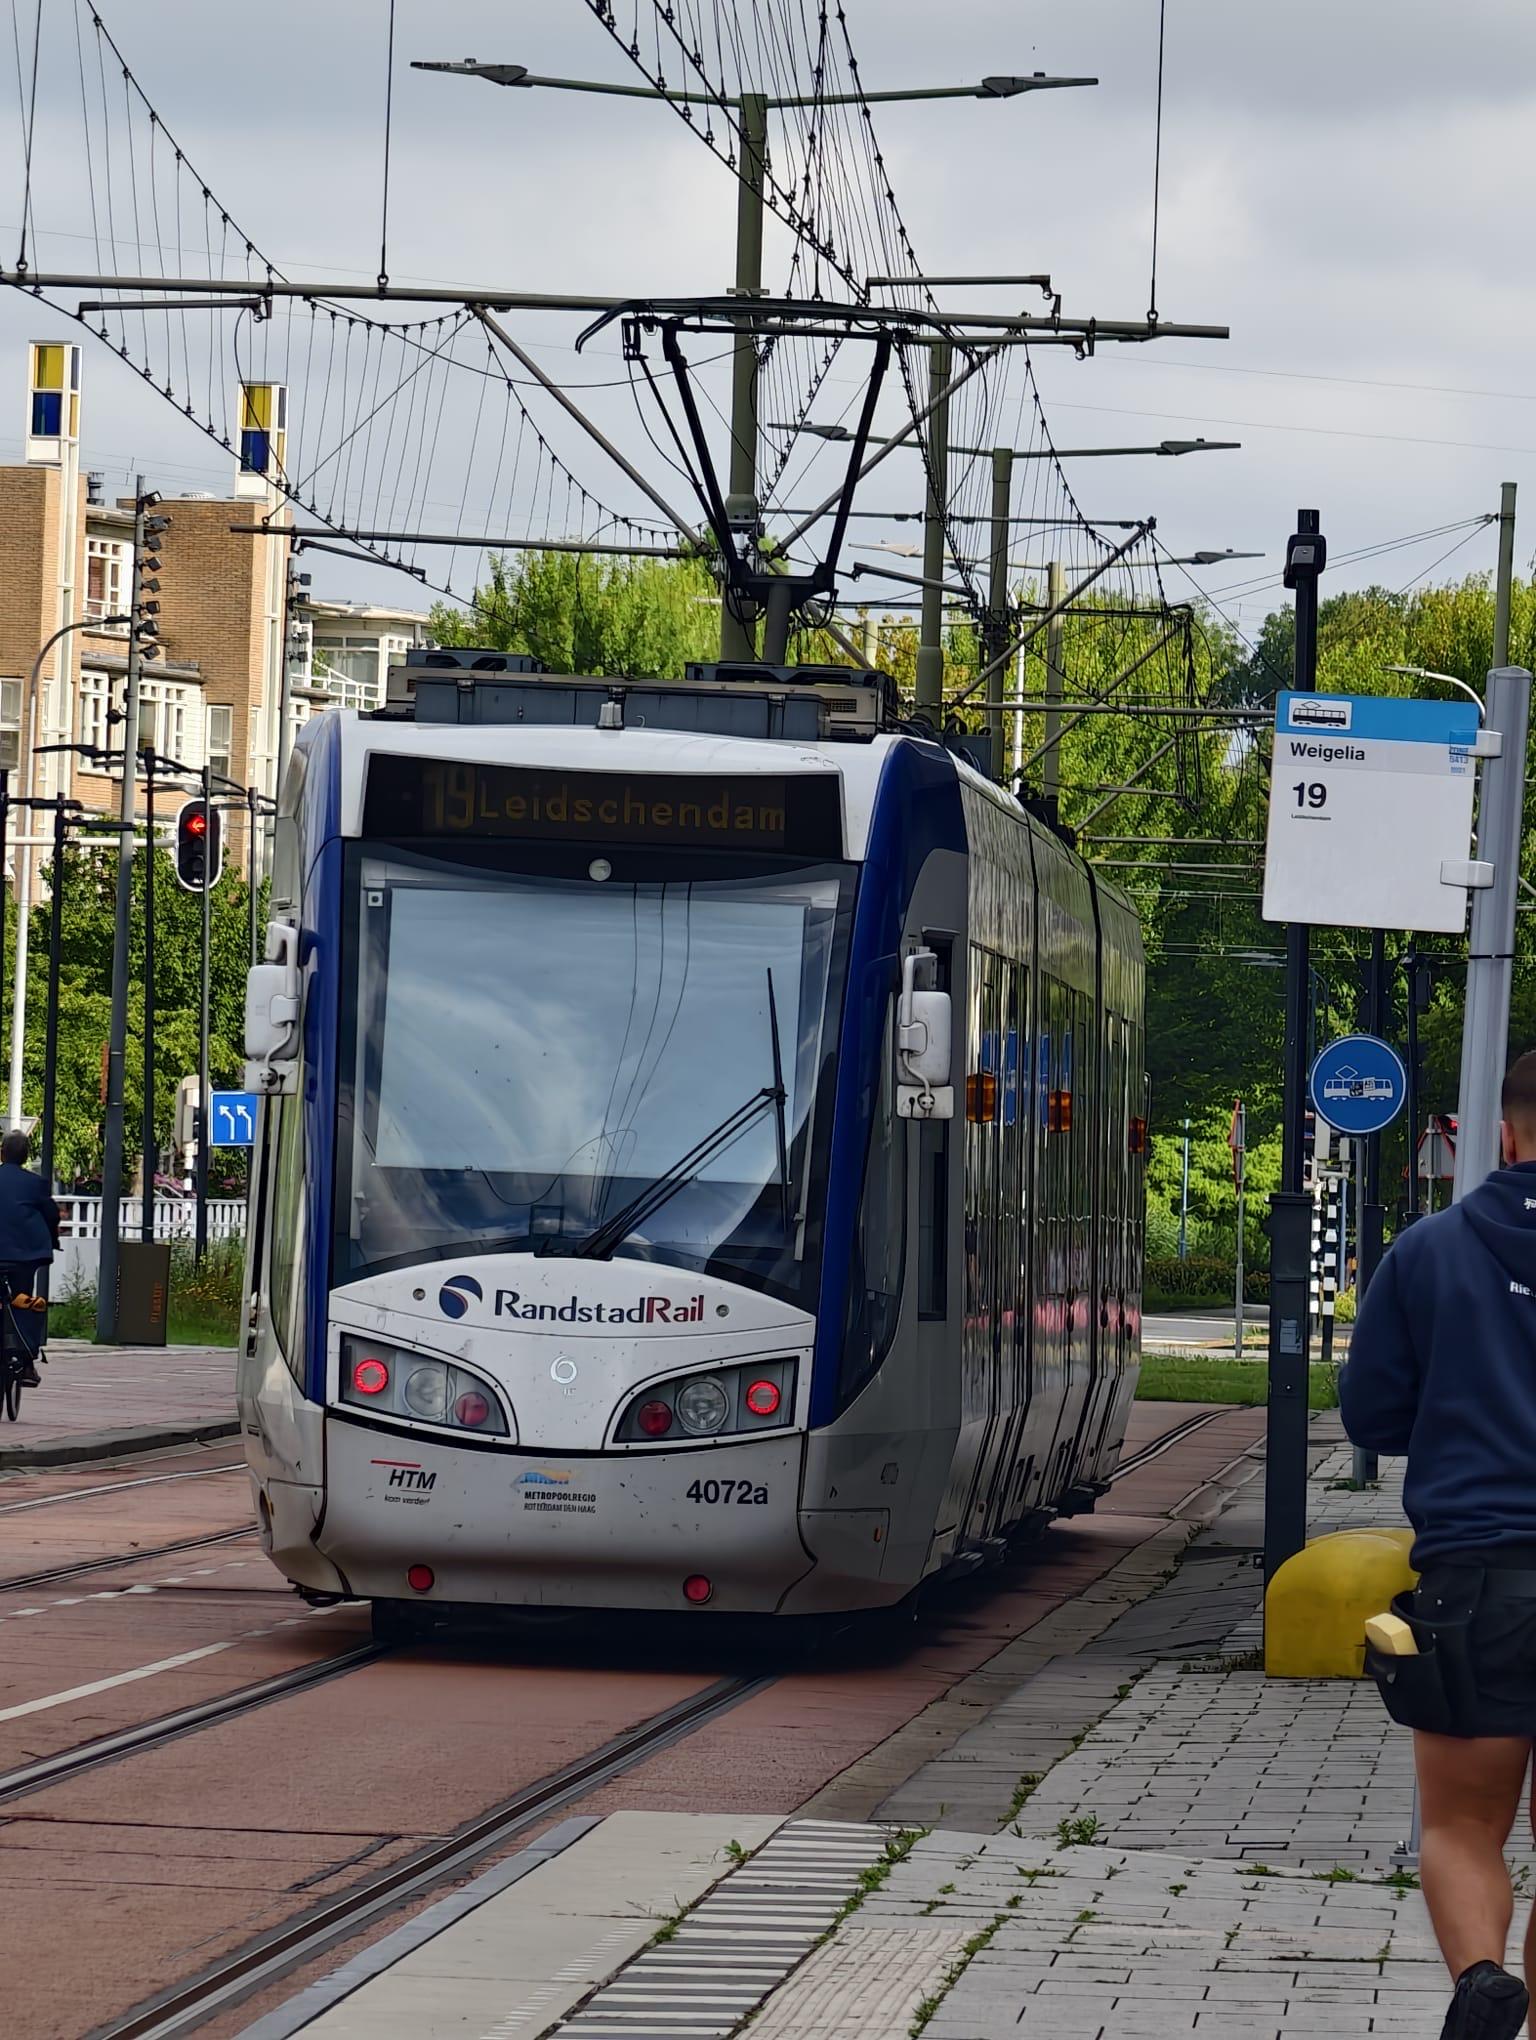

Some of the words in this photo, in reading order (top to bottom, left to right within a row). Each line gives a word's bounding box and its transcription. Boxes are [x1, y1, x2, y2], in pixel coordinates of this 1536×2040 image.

[1291, 742, 1365, 761] Weigelia
[479, 779, 786, 831] Leidschendam
[1292, 782, 1327, 809] 19
[1509, 1281, 1531, 1295] Rie
[494, 1289, 704, 1324] RandstadRail
[389, 1469, 437, 1490] HTM
[524, 1491, 597, 1502] METROPOOLREGIO
[686, 1479, 769, 1505] 4072a
